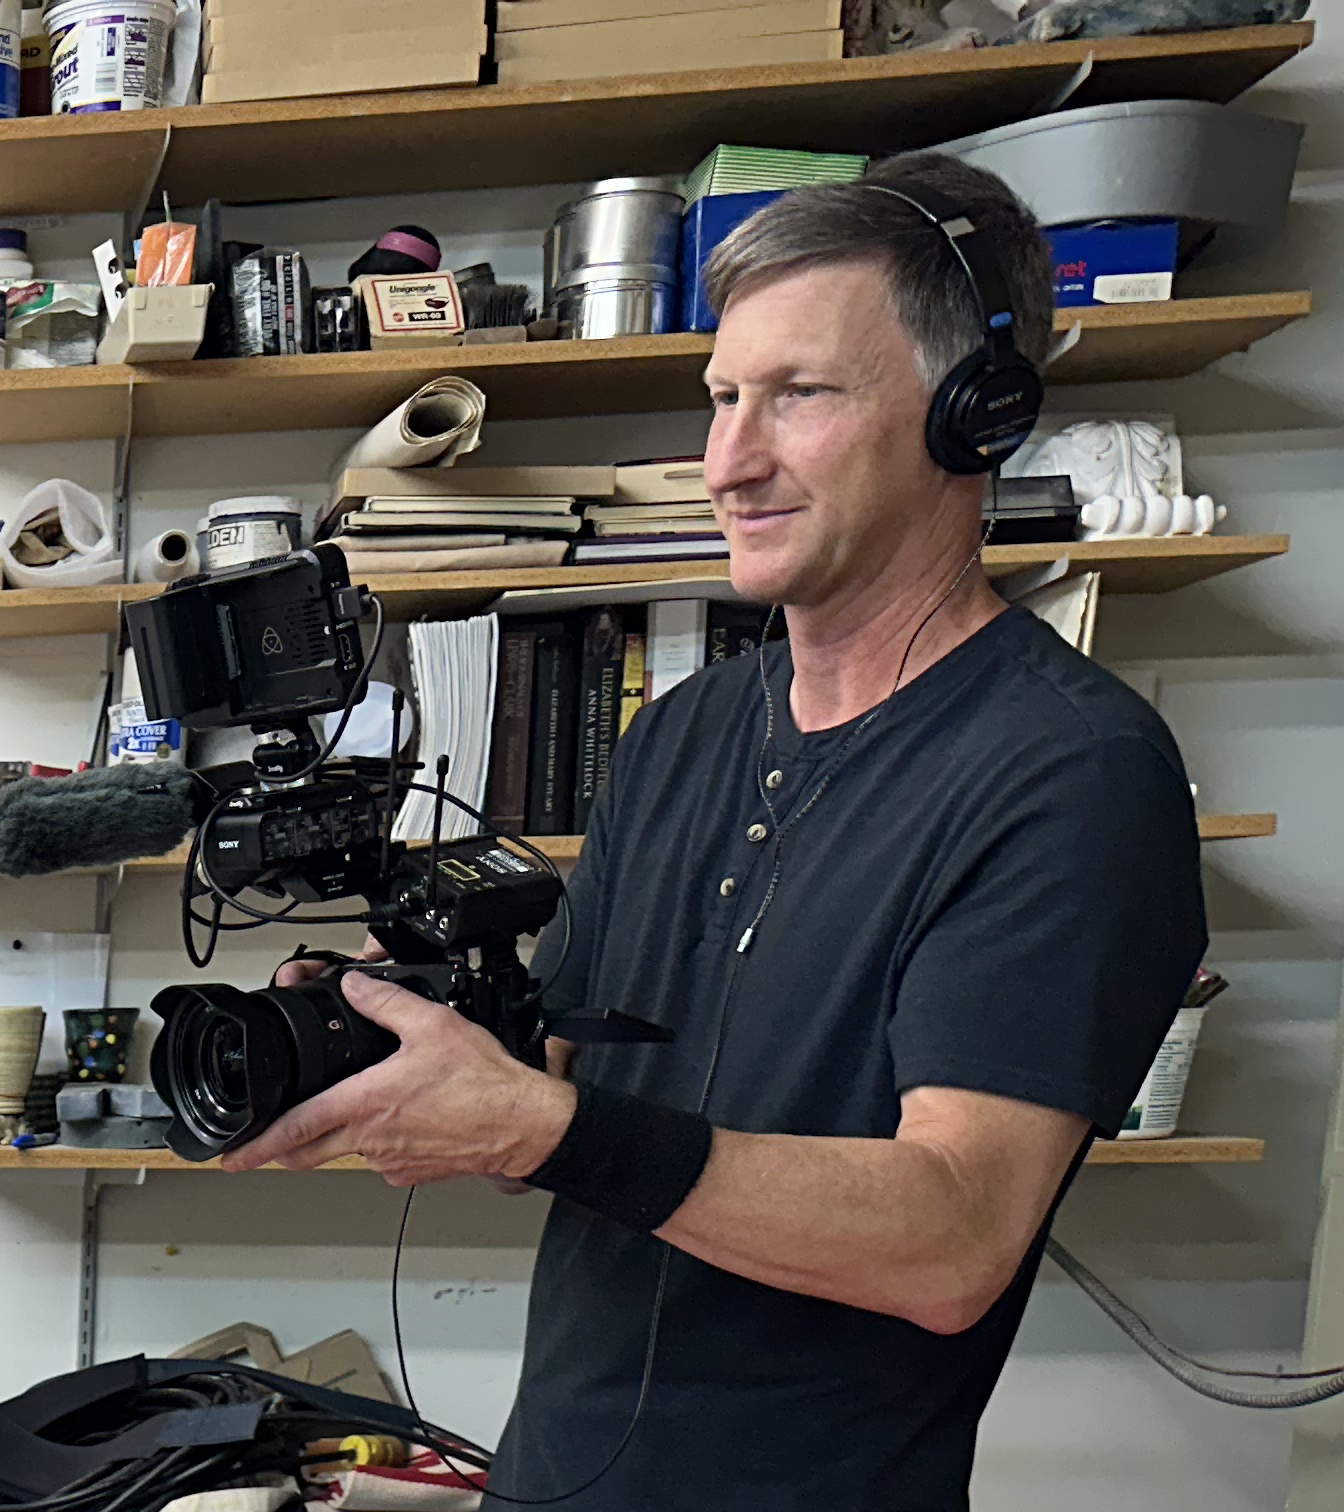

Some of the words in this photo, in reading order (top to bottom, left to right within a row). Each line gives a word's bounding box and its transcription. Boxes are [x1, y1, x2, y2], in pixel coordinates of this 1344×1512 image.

[988, 391, 1023, 411] SONY
[208, 526, 245, 549] DEN
[586, 689, 597, 723] ANNA
[135, 725, 167, 737] COVER
[583, 727, 597, 799] WHITELOCK
[218, 840, 239, 850] SONY
